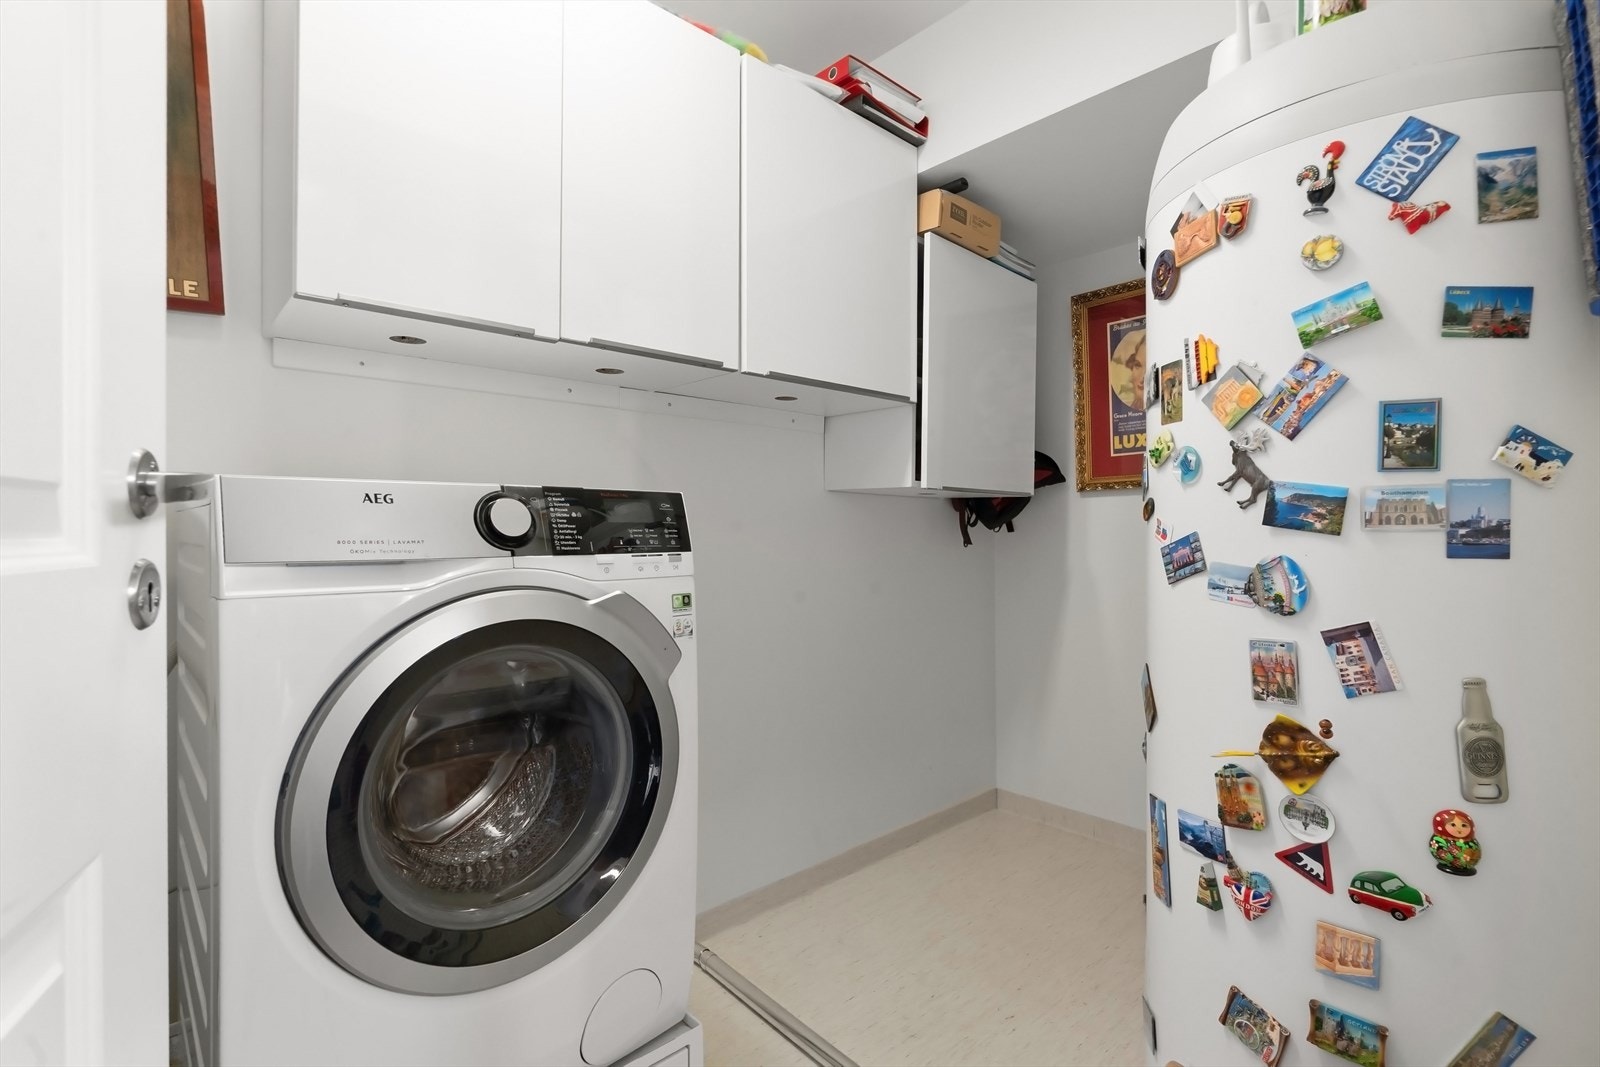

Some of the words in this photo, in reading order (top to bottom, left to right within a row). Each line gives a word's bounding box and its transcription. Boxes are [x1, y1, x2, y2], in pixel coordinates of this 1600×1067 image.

[1114, 433, 1146, 450] LUX
[362, 493, 394, 504] AEG
[1381, 489, 1429, 497] Southampton
